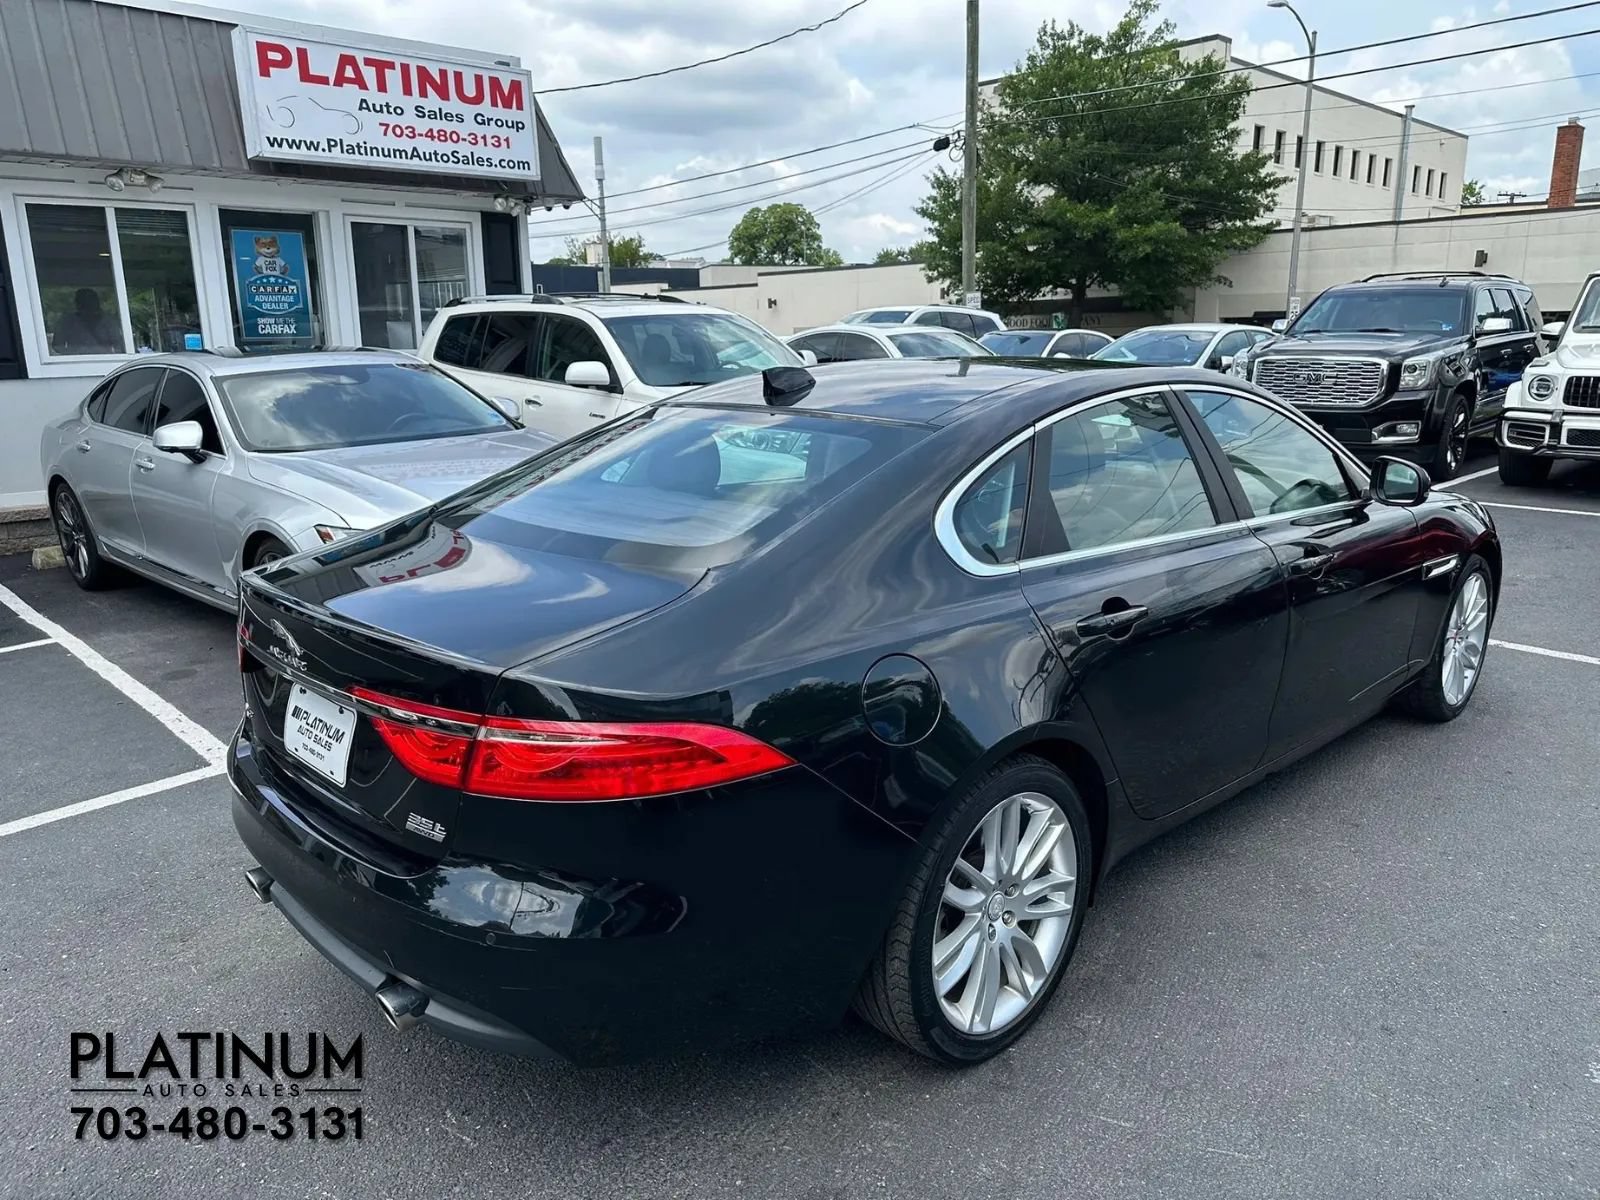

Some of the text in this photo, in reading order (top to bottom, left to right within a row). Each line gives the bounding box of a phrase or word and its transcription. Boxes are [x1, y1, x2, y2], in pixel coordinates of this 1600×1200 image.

[255, 40, 524, 111] PLATINUM
[358, 98, 526, 132] Auto Sales Group
[378, 122, 511, 150] 703-480-3131
[266, 136, 531, 171] www.PlatinumAutoSales.com
[251, 286, 297, 294] CARFAX
[255, 294, 294, 302] ADVANTAGE
[258, 324, 297, 334] CARFAX
[1293, 371, 1337, 384] GMC
[297, 725, 333, 752] AUTO SALES
[300, 710, 345, 744] PLATINUM
